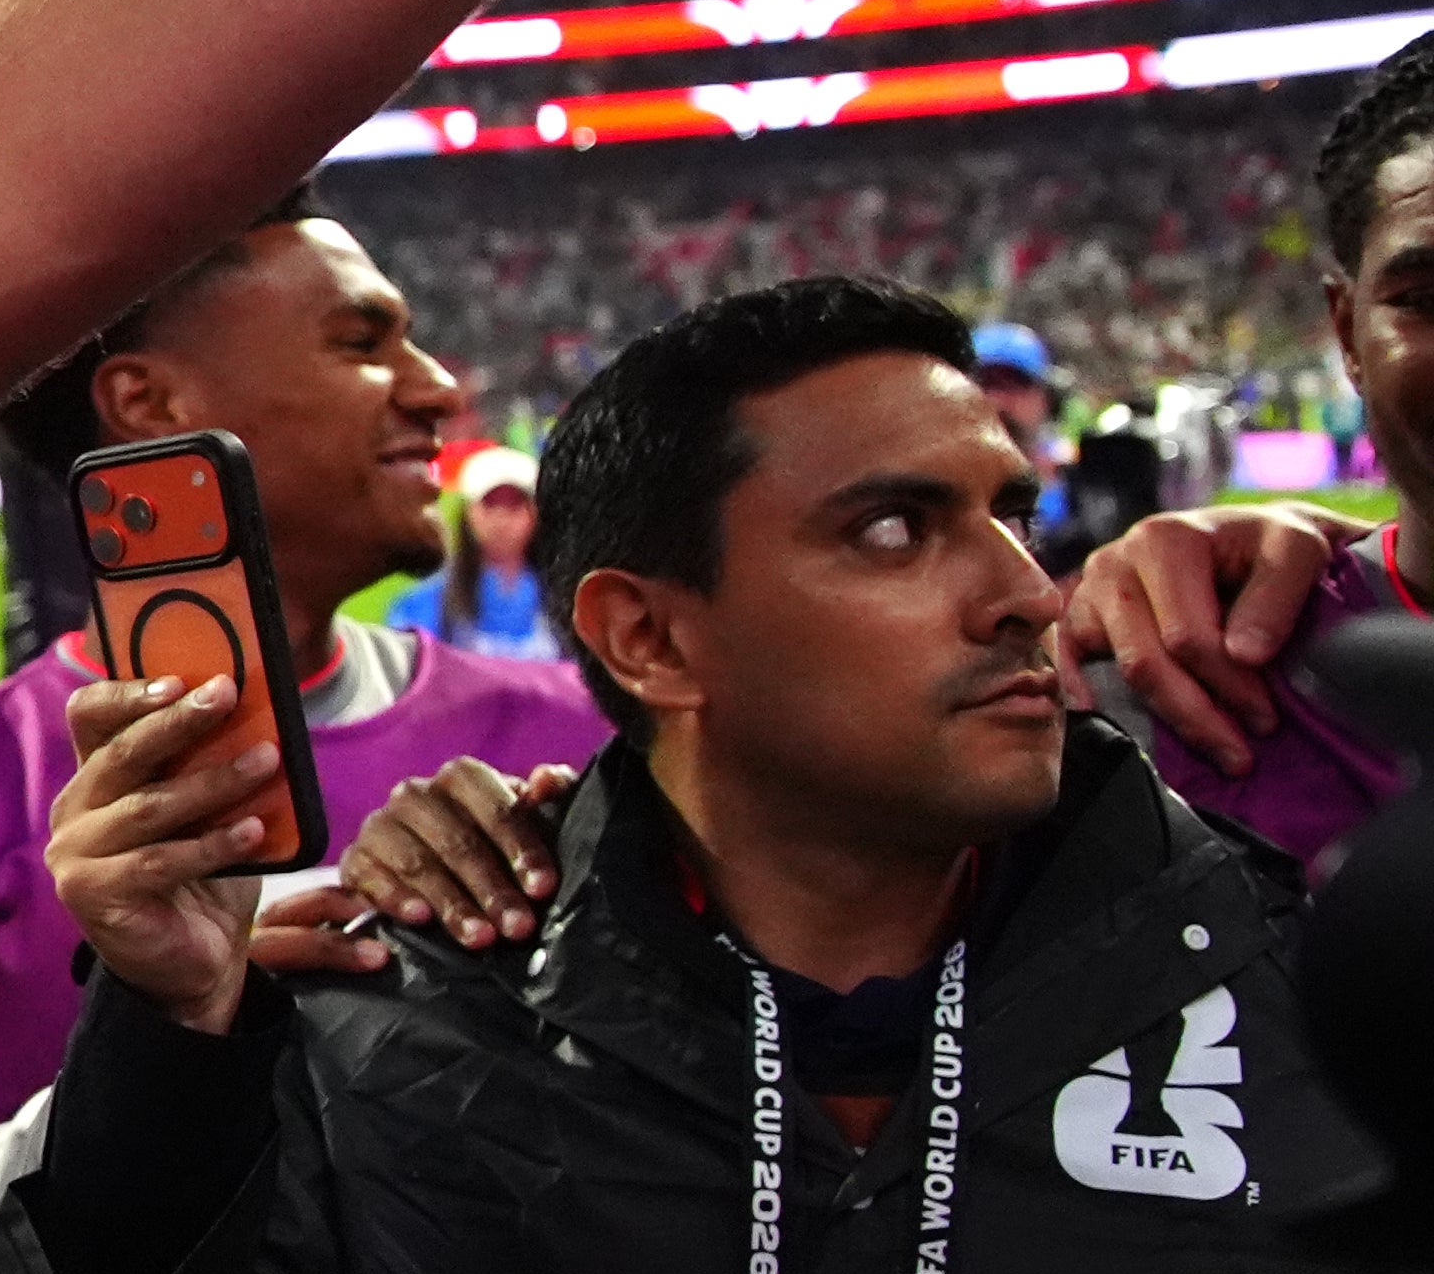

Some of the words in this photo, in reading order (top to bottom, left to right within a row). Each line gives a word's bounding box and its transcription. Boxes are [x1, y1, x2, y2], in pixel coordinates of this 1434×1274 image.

[933, 940, 966, 1030] 2026
[749, 968, 782, 1083] WORLD
[930, 1031, 963, 1101] CUP
[753, 1086, 784, 1157] CUP
[1111, 1144, 1196, 1175] FIFA
[919, 1104, 960, 1231] WORLD
